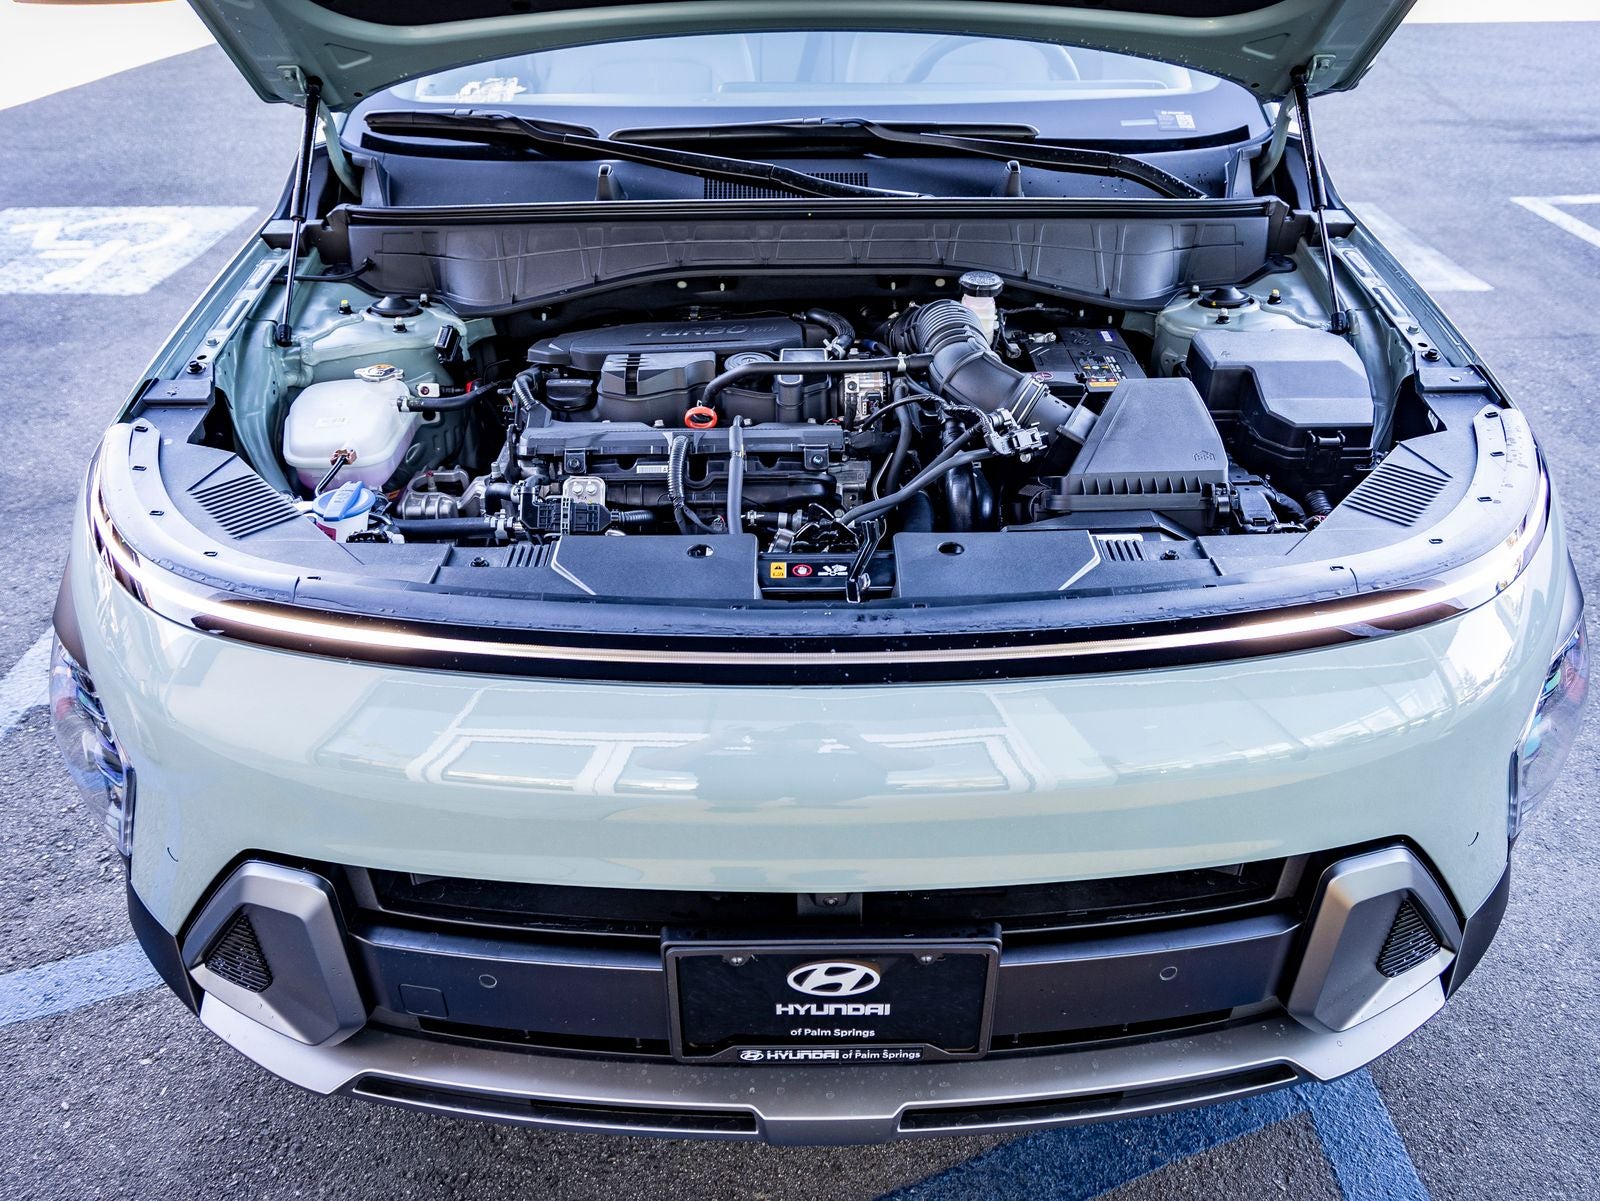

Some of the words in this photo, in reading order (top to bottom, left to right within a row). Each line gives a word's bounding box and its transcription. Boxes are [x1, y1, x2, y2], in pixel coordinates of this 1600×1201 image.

[643, 324, 748, 337] TURBO
[776, 1003, 891, 1015] HYUNDAI
[790, 1028, 802, 1036] of
[804, 1028, 830, 1036] Palm
[833, 1028, 875, 1038] Springs
[766, 1050, 839, 1060] HYUNDAI
[842, 1049, 852, 1059] of
[855, 1049, 880, 1059] Palm
[882, 1049, 921, 1060] Springs
